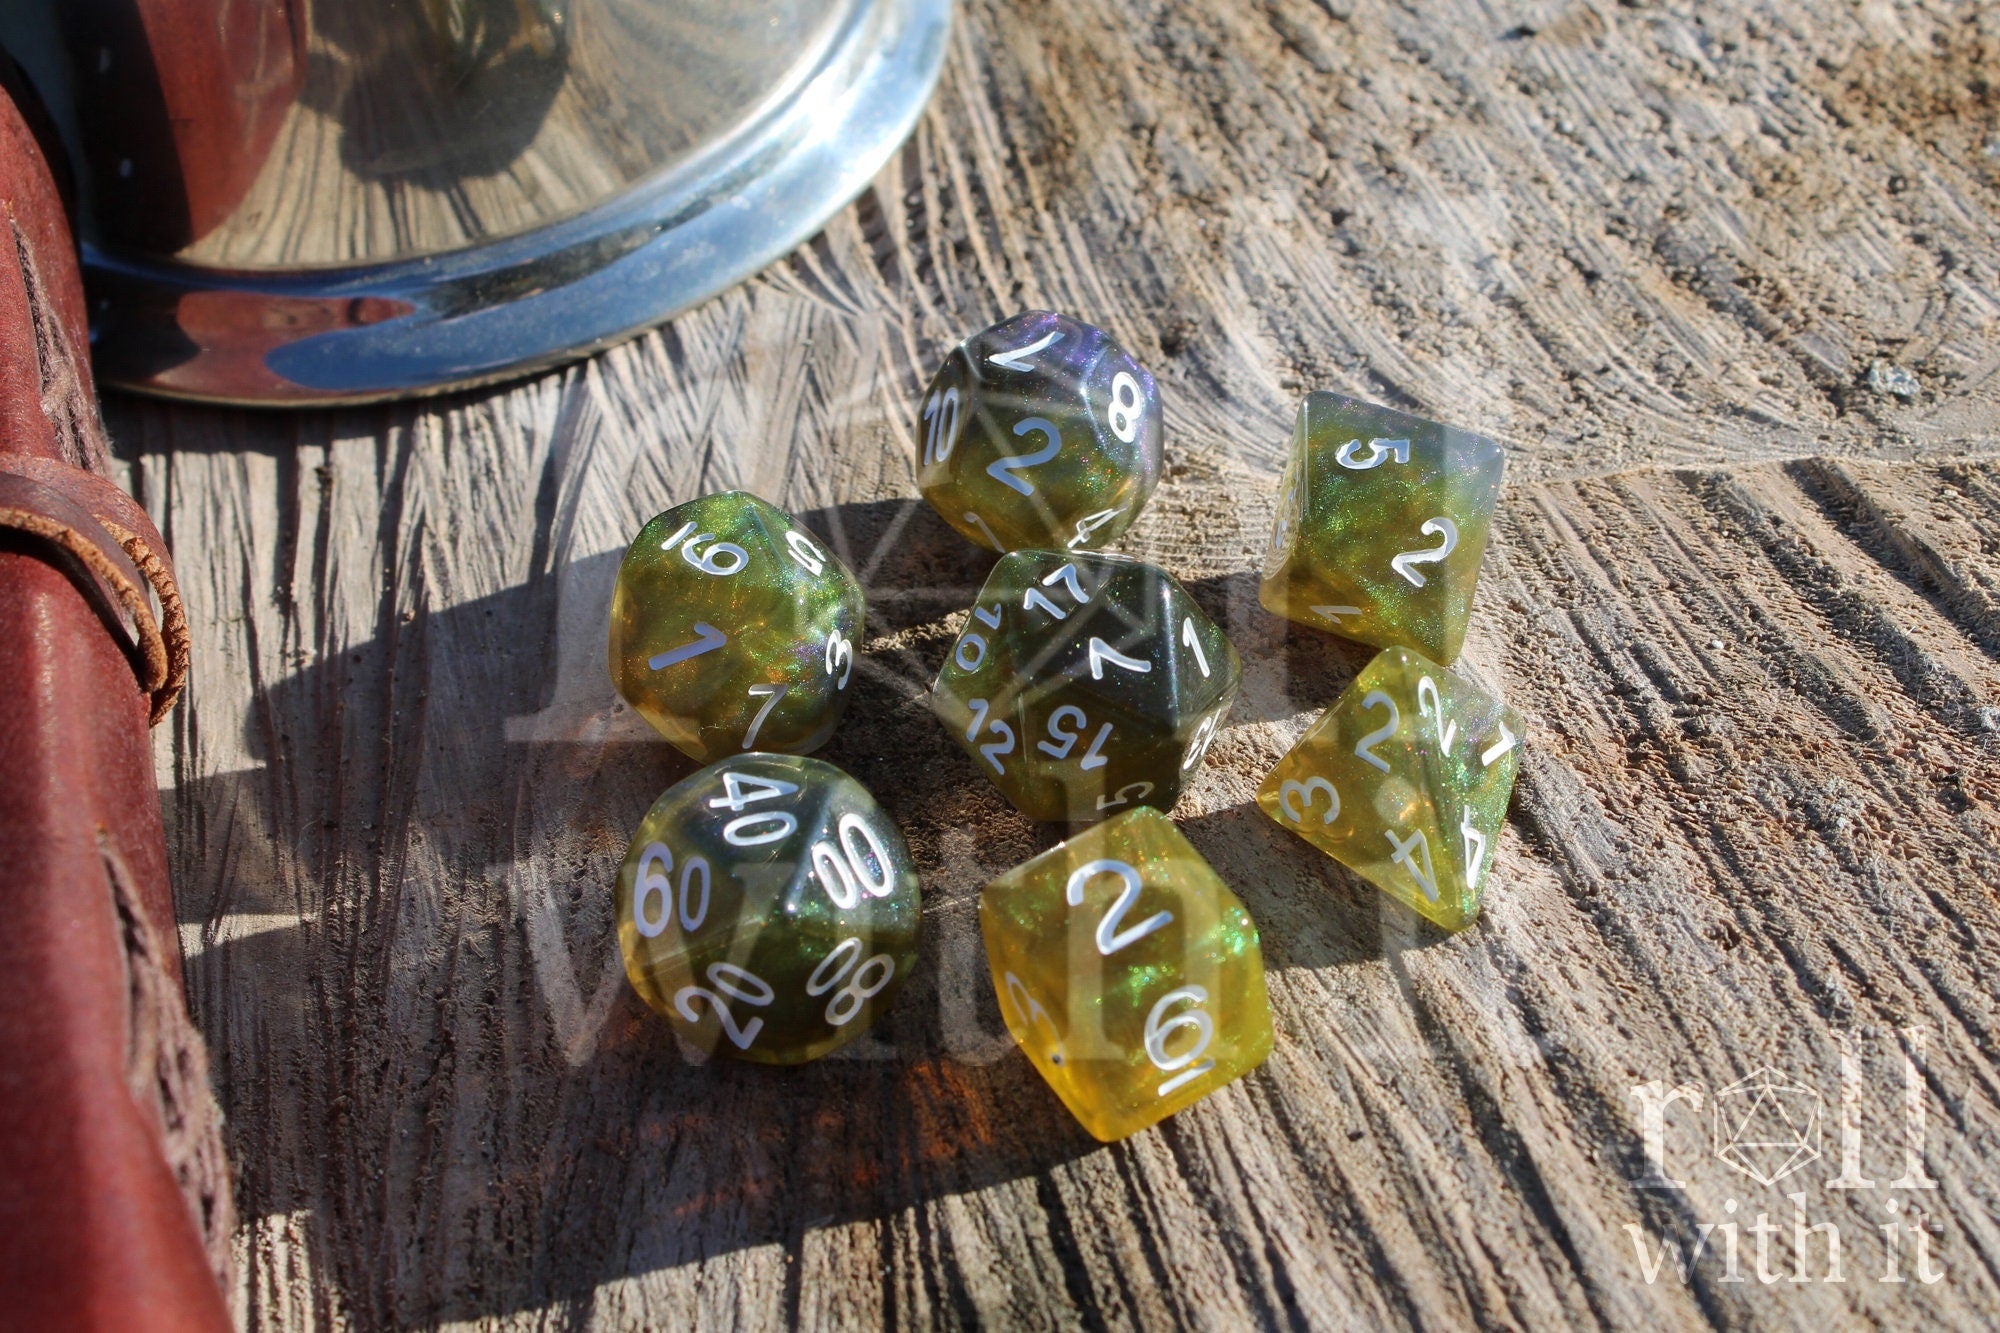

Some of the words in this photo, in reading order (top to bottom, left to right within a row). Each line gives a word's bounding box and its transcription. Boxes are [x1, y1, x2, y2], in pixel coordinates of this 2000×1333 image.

[924, 387, 959, 466] 10
[1107, 371, 1143, 443] 8
[986, 416, 1062, 496] 2
[1336, 438, 1410, 469] 5
[785, 530, 826, 577] 5
[1391, 517, 1458, 587] 2
[1023, 563, 1089, 620] 17
[648, 622, 727, 671] 1
[826, 629, 853, 690] 3
[955, 603, 1001, 671] 10
[1089, 637, 1151, 680] 7
[1182, 617, 1210, 677] 1
[742, 684, 788, 749] 7
[966, 698, 1015, 775] 12
[1037, 705, 1113, 770] 15
[1354, 690, 1399, 773] 2
[1418, 675, 1457, 757] 2
[1482, 721, 1516, 766] 1
[709, 772, 799, 846] 40
[1279, 776, 1341, 825] 3
[812, 813, 894, 909] 00
[1385, 828, 1439, 903] 4
[1461, 805, 1486, 890] 4
[634, 841, 710, 938] 60
[1066, 859, 1174, 955] 2
[674, 962, 775, 1050] 20
[806, 937, 895, 1026] 80
